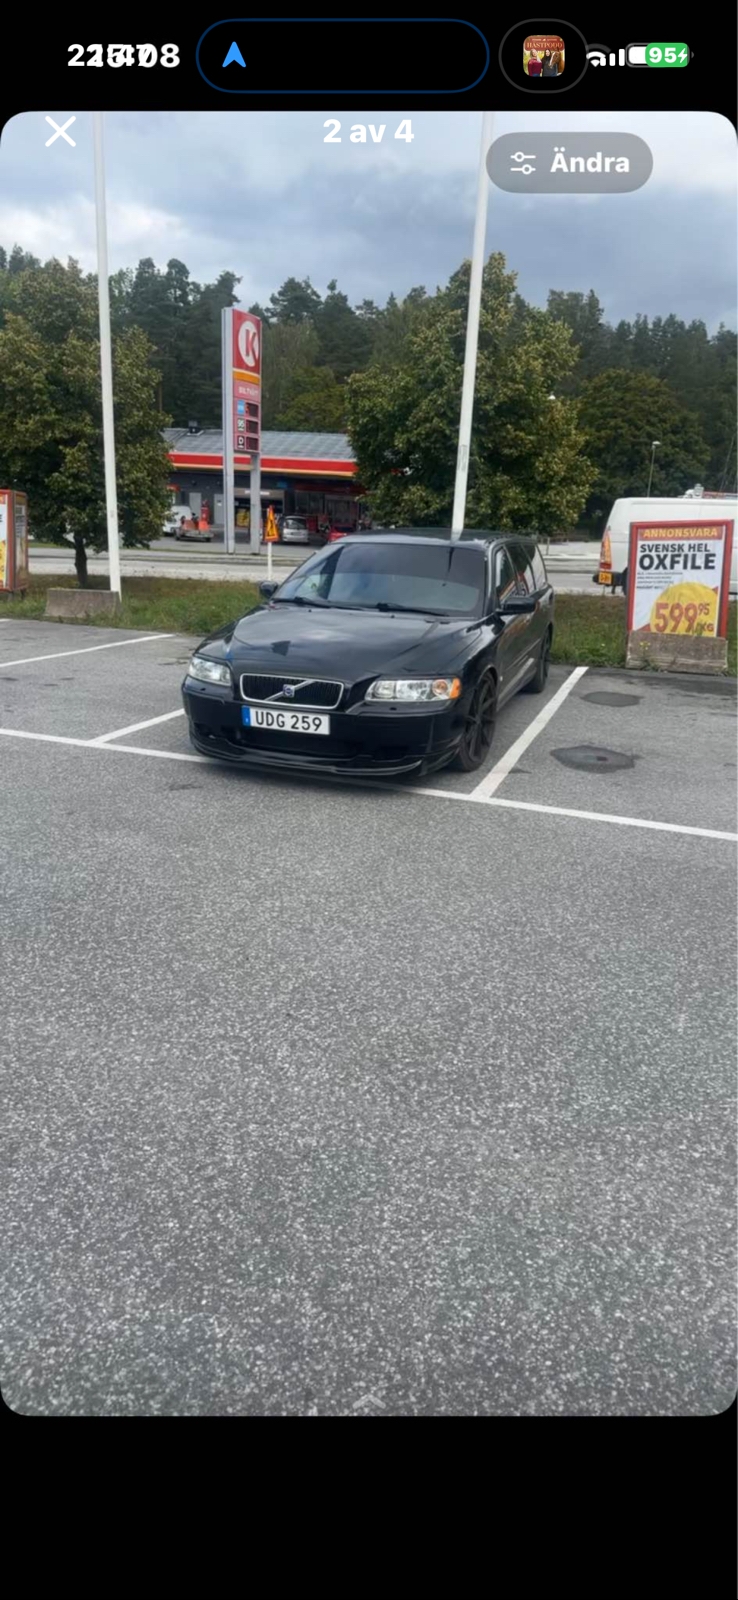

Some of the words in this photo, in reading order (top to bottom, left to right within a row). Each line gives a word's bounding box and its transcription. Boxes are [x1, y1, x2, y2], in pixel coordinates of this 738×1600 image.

[246, 328, 258, 361] K
[643, 528, 718, 538] ANNONSVARA
[640, 543, 685, 553] SVENSK
[688, 543, 710, 553] HEL
[639, 553, 716, 570] OXFILE
[655, 602, 698, 633] 599
[255, 710, 285, 728] UDG
[291, 714, 322, 732] 259
